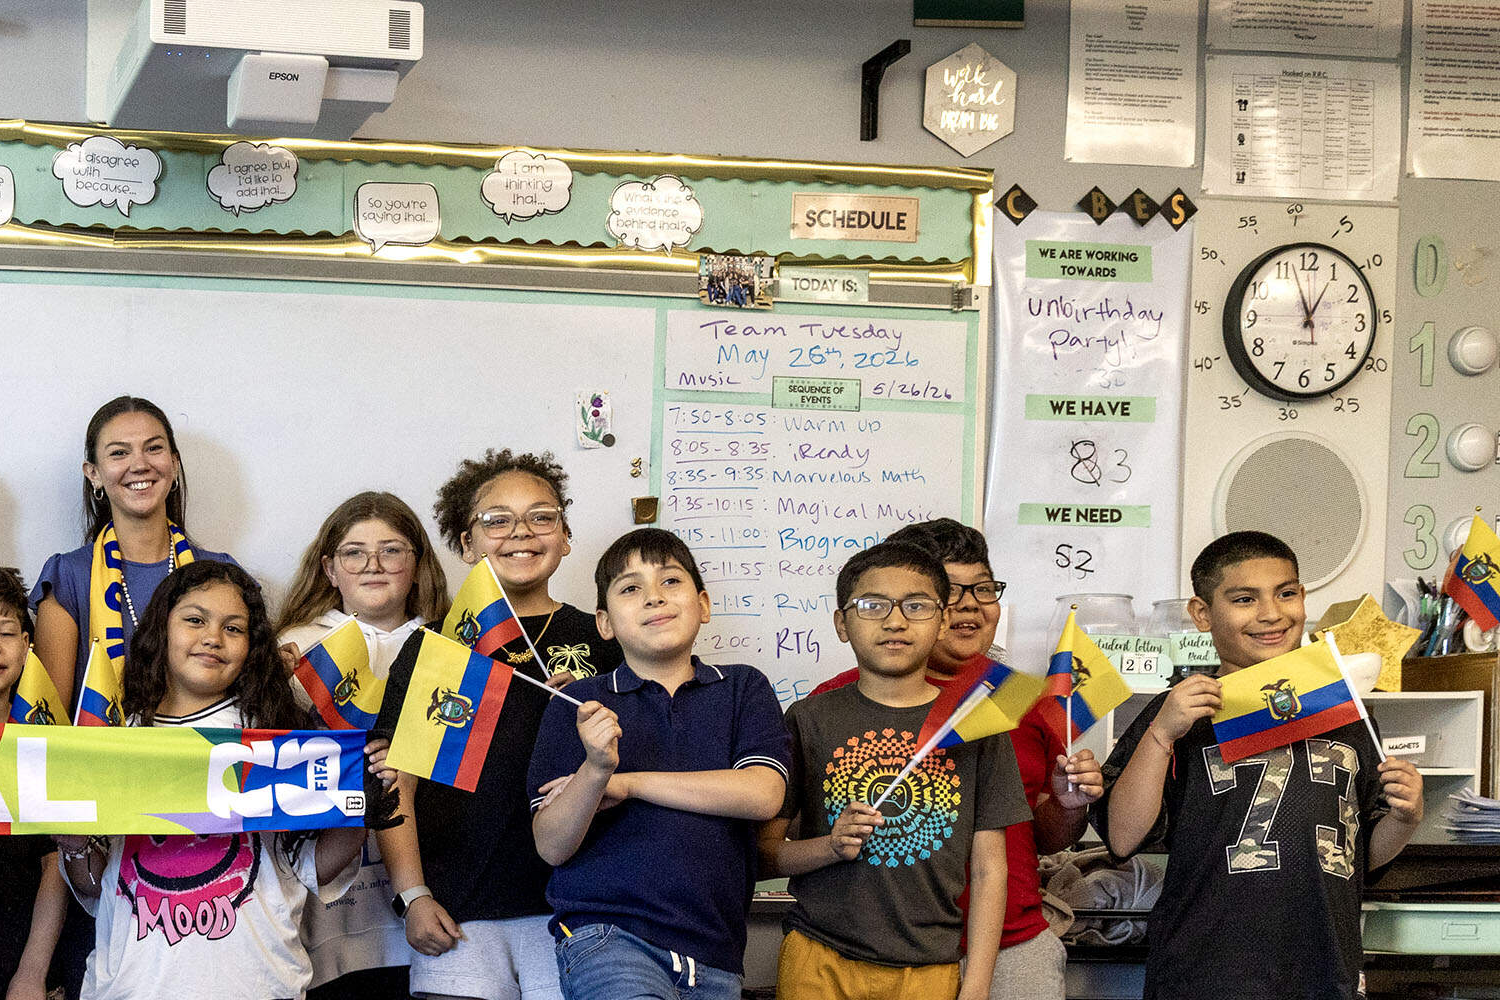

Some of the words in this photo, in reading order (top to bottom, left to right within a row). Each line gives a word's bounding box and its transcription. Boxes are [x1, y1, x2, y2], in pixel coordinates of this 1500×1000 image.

[269, 72, 299, 82] EPSON
[943, 63, 991, 88] work
[947, 82, 1005, 107] hard
[941, 111, 974, 132] DREAM
[85, 153, 140, 168] disagree
[272, 160, 291, 170] but
[72, 166, 100, 178] with
[522, 164, 545, 175] am
[75, 179, 137, 195] because...
[253, 174, 269, 184] like
[271, 173, 282, 184] to
[505, 178, 553, 192] thinking
[236, 186, 258, 197] add
[624, 191, 653, 203] What
[368, 197, 382, 209] So
[384, 199, 428, 212] you're
[626, 206, 679, 218] evidence
[1286, 203, 1304, 214] 60
[362, 210, 401, 224] saying
[616, 219, 656, 230] behind
[659, 220, 687, 232] that?
[805, 209, 907, 231] SCHEDULE
[1237, 216, 1258, 229] 55
[1340, 215, 1354, 233] 5
[1039, 248, 1056, 259] WE
[1060, 249, 1082, 261] ARE
[1085, 250, 1139, 262] WORKING
[1201, 248, 1218, 260] 50
[1300, 252, 1319, 271] 12
[1060, 265, 1117, 278] TOWARDS
[1275, 261, 1290, 280] 11
[1330, 263, 1338, 281] 1
[1412, 234, 1447, 298] 0
[791, 277, 838, 292] TODAY
[842, 278, 858, 293] IS:
[1250, 281, 1269, 300] 10
[1346, 284, 1359, 303] 2
[1245, 309, 1258, 329] 9
[1354, 313, 1366, 332] 3
[1377, 308, 1393, 324] 15
[700, 319, 788, 341] Team
[799, 322, 903, 351] Tuesday
[1252, 337, 1264, 356] 8
[1345, 341, 1357, 360] 4
[1408, 320, 1436, 387] 1
[716, 343, 770, 380] May
[853, 350, 921, 369] 2026
[1194, 356, 1214, 372] 40
[1365, 356, 1388, 373] 20
[678, 370, 742, 386] Music
[1272, 361, 1285, 380] 7
[1298, 369, 1310, 388] 6
[1324, 362, 1336, 381] 5
[788, 385, 830, 395] SEQUENCE
[833, 386, 845, 395] OF
[872, 381, 953, 400] 5/26/26
[800, 395, 832, 405] EVENTS
[1050, 400, 1076, 415] WE
[1081, 401, 1131, 417] HAVE
[1218, 395, 1242, 410] 35
[1333, 397, 1360, 413] 25
[1278, 408, 1299, 421] 30
[784, 416, 847, 433] Warm
[857, 418, 882, 433] up
[1403, 412, 1441, 479] 2
[1108, 448, 1132, 483] 3
[772, 469, 872, 484] Marvelous
[881, 466, 926, 485] Math
[777, 497, 867, 524] Magical
[1045, 507, 1071, 522] WE
[1076, 508, 1123, 523] NEED
[1402, 504, 1439, 570] 3
[1055, 543, 1094, 574] 52
[774, 594, 835, 610] RWT
[775, 627, 820, 663] RTG
[1134, 638, 1163, 654] lottery
[1388, 741, 1420, 750] MAGNETS
[313, 755, 329, 792] FIFA
[136, 895, 237, 946] MOOD
